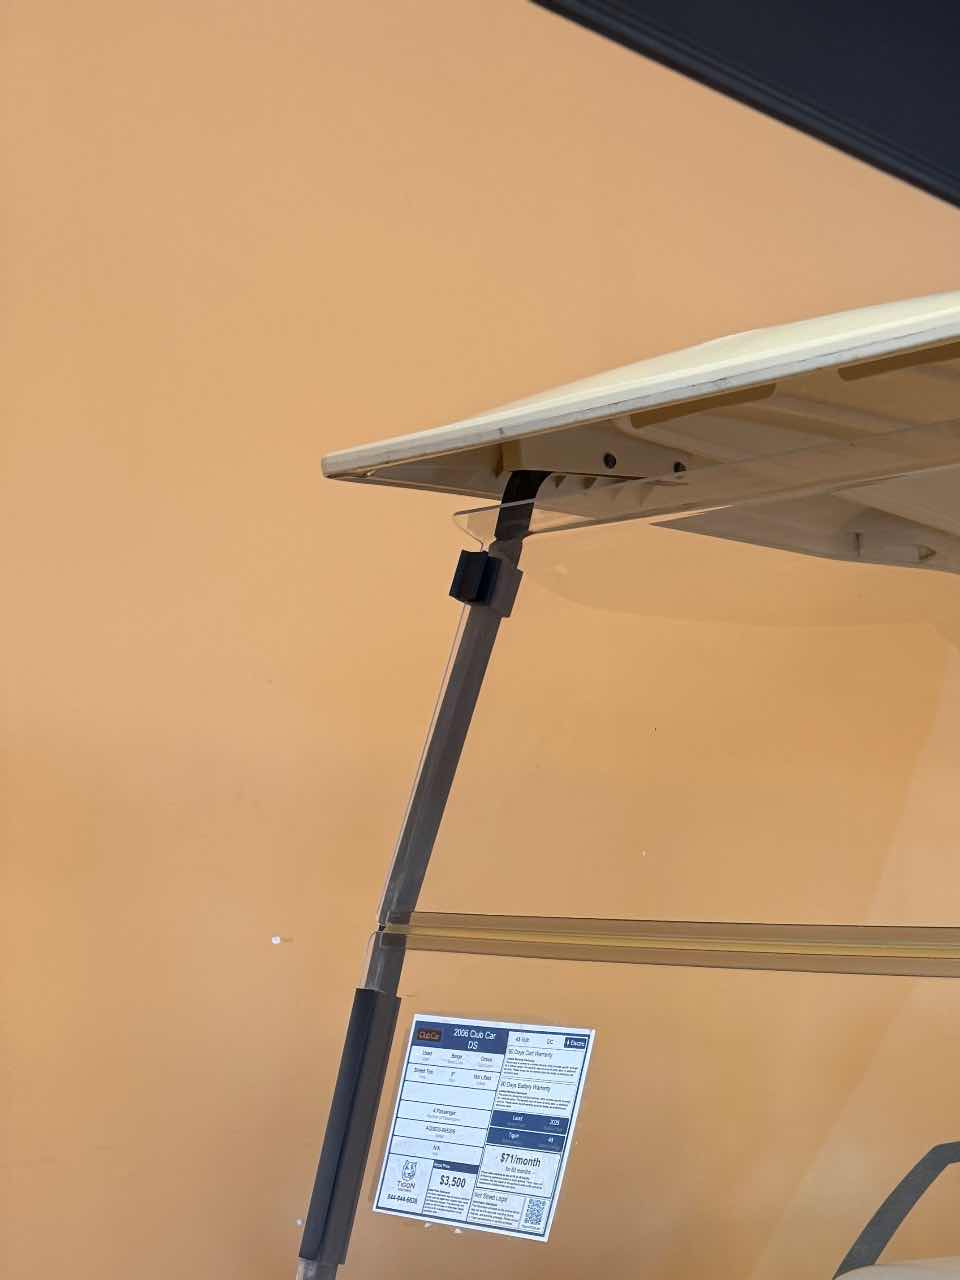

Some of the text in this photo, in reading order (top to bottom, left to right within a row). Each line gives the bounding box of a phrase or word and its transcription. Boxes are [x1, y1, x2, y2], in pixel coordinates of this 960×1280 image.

[469, 1030, 484, 1039] Club
[484, 1031, 497, 1040] Car
[467, 1040, 479, 1050] DS
[500, 1152, 541, 1167] $71/month
[440, 1174, 466, 1188] $3,500
